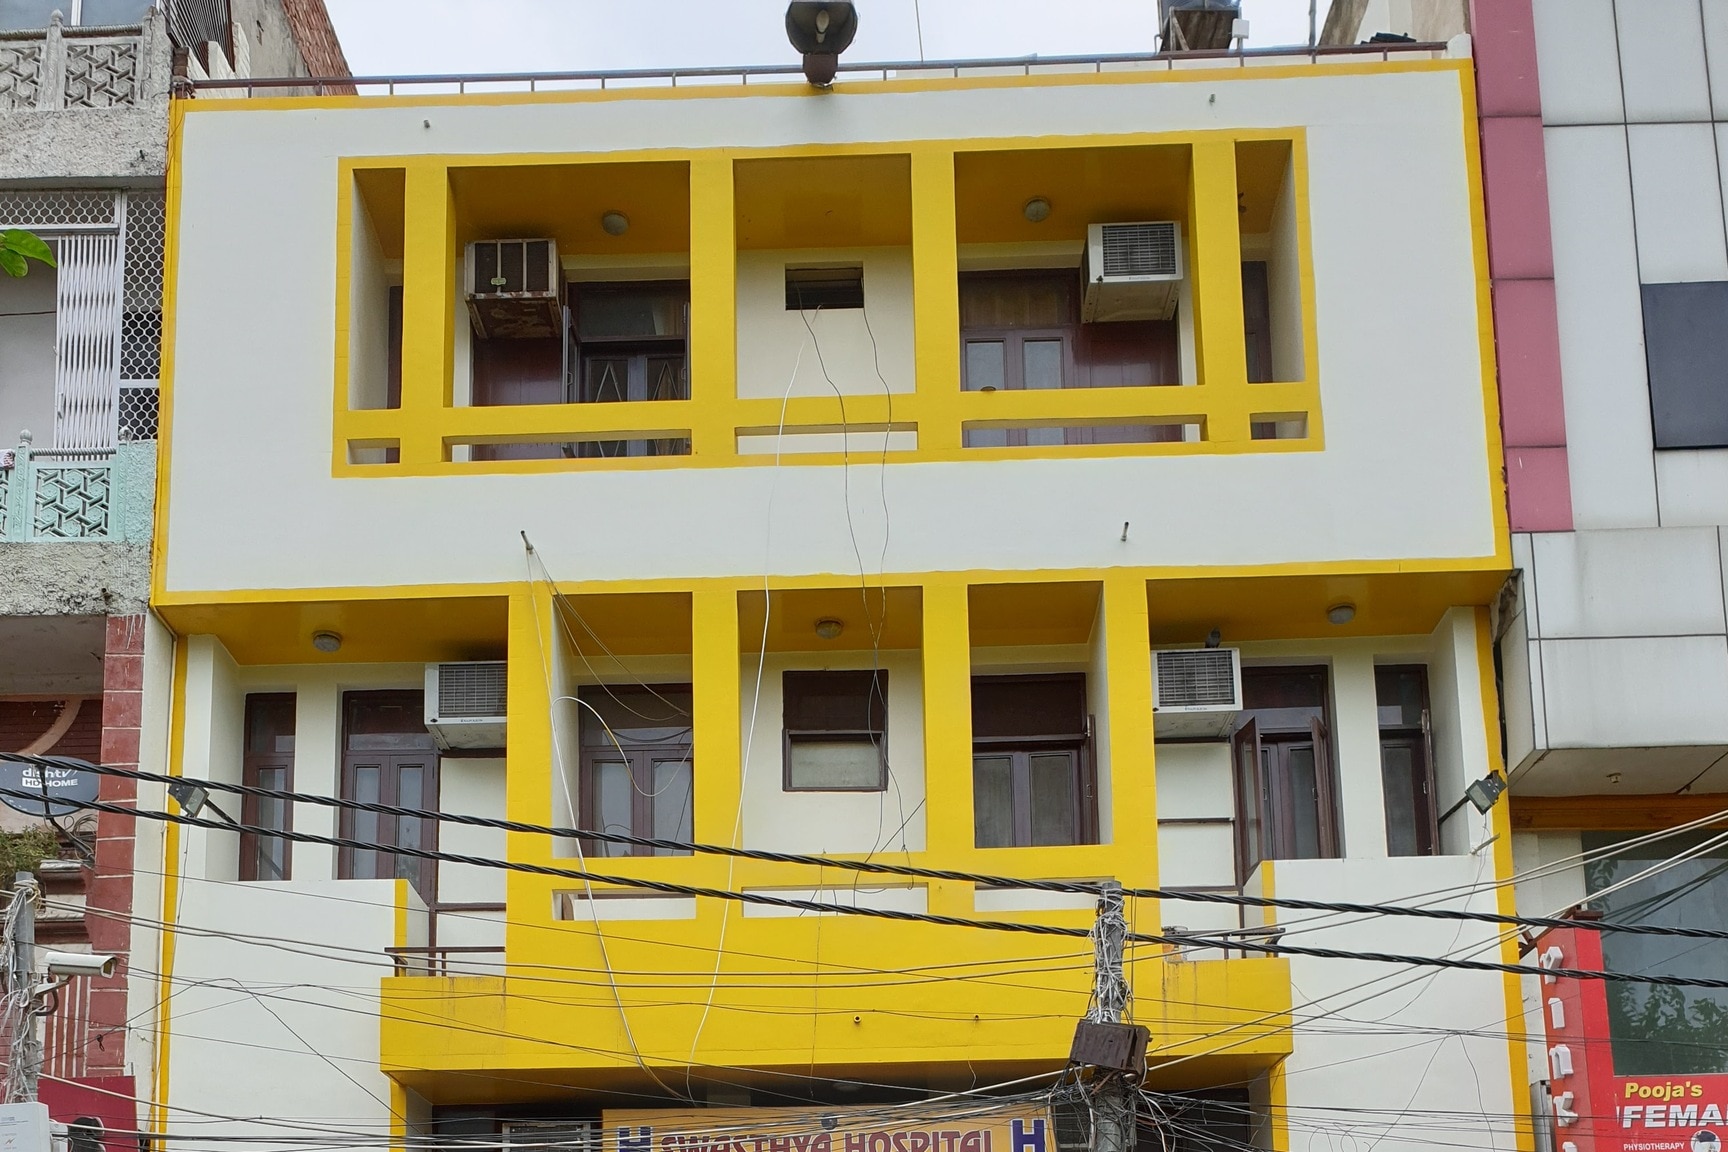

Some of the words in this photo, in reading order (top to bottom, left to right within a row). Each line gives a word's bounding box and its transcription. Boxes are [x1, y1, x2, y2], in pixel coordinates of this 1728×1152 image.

[45, 779, 78, 787] HOME
[1625, 1081, 1703, 1102] Pooja's
[1622, 1103, 1728, 1129] FEMA
[1623, 1142, 1685, 1151] PHYSIOTHERAPY
